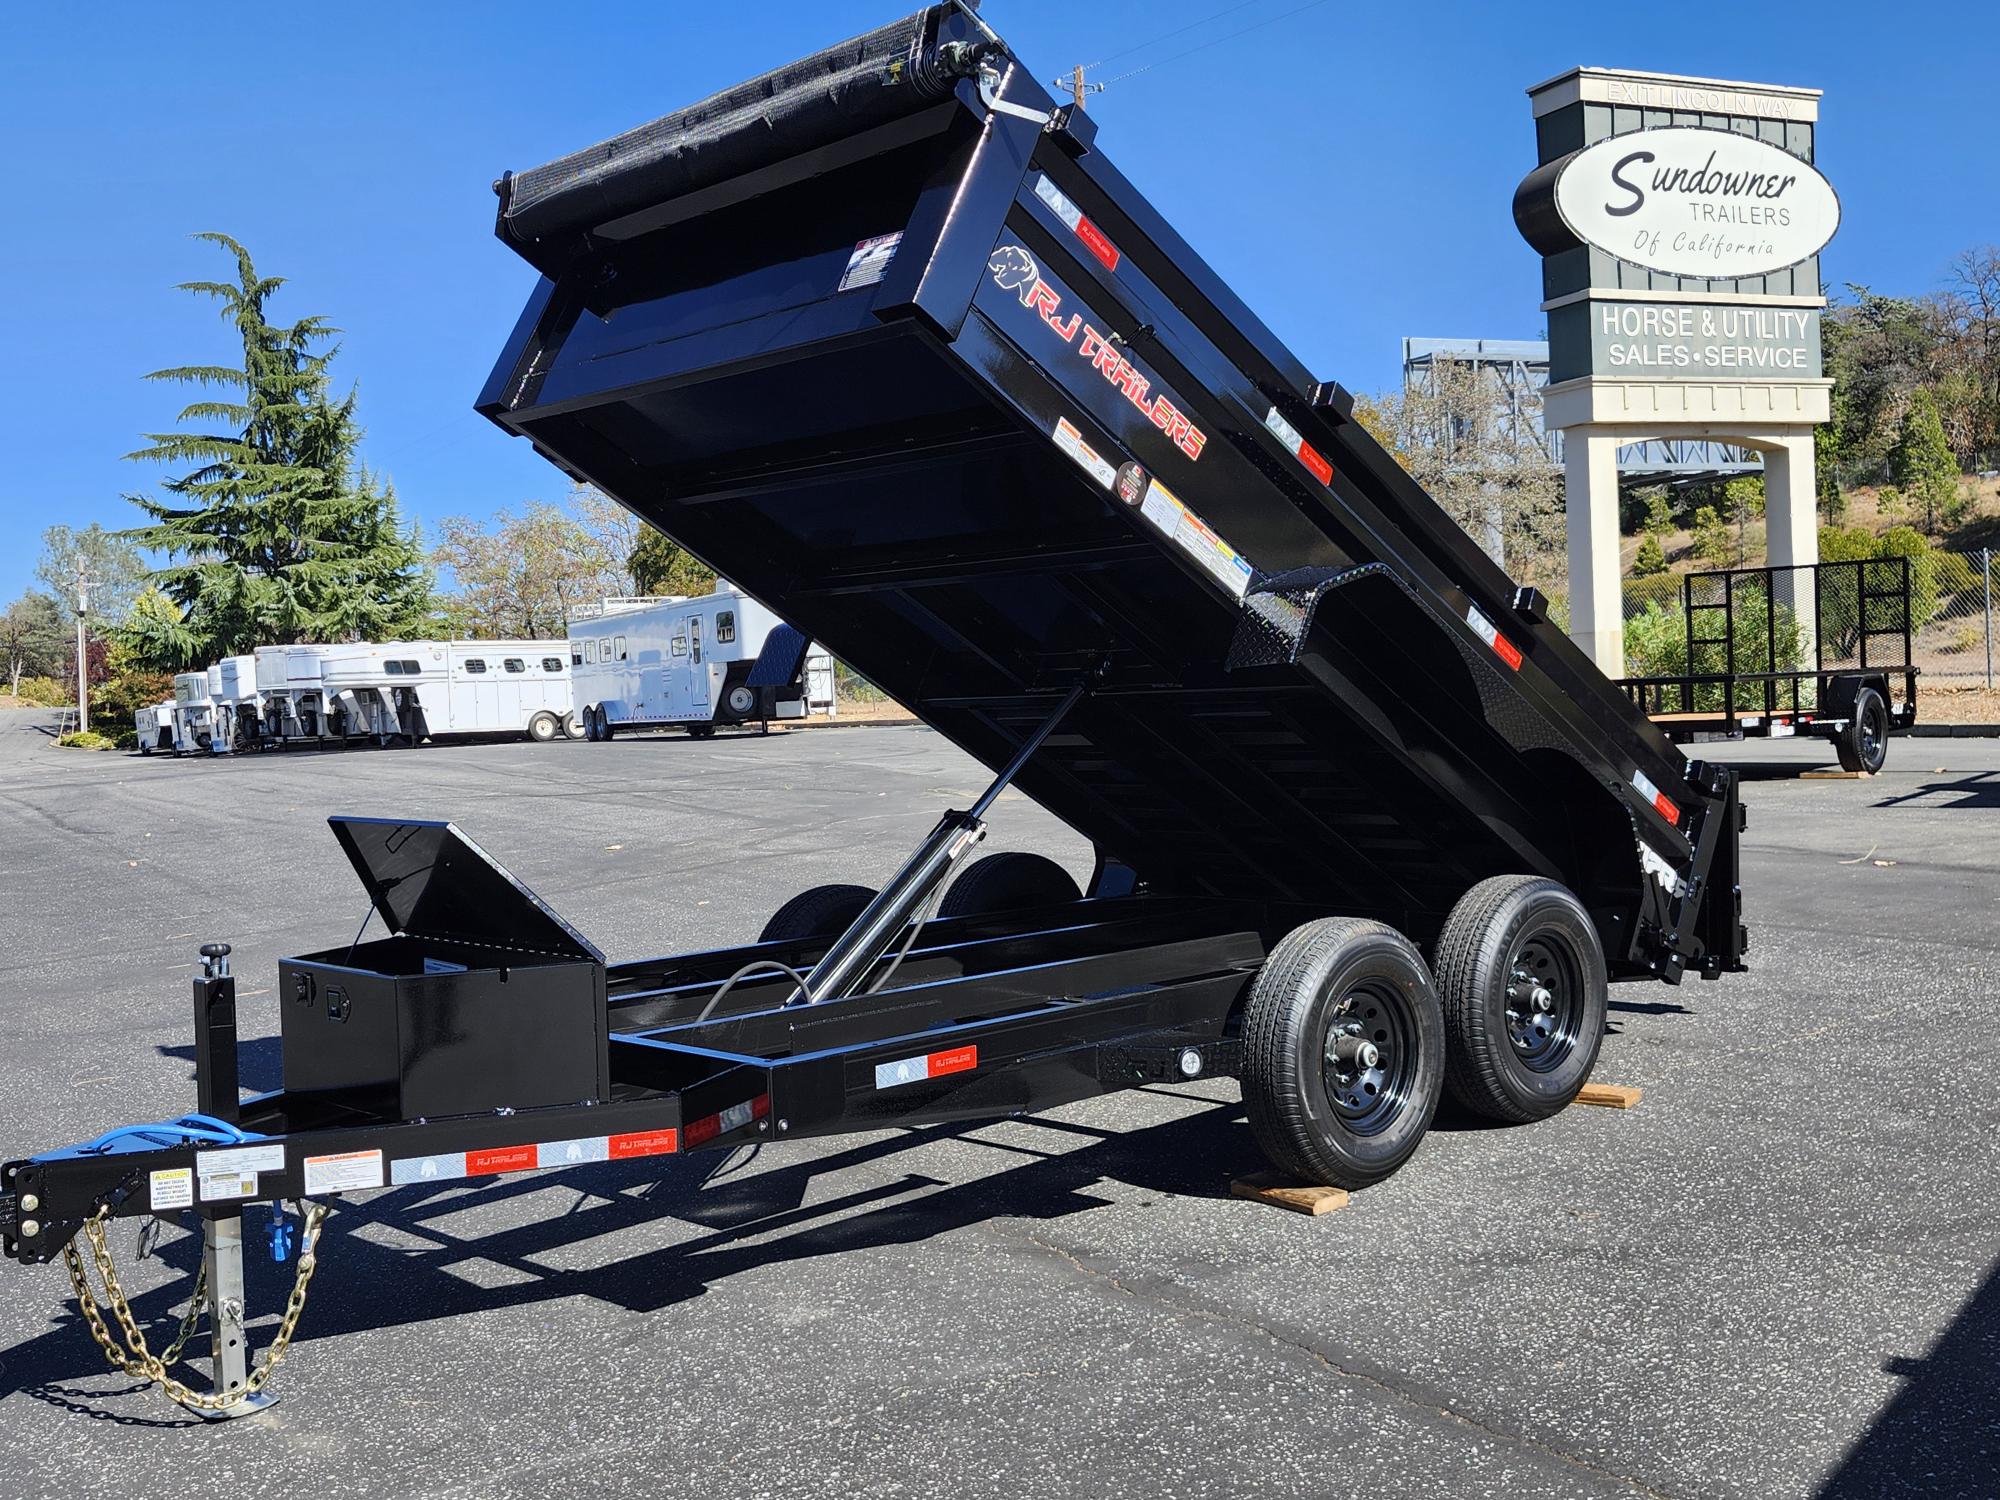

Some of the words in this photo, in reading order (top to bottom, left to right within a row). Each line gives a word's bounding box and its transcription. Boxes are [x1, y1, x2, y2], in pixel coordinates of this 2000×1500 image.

[1607, 82, 1654, 104] EXIT
[1660, 87, 1748, 113] LINCOLN
[1754, 96, 1793, 119] WAY
[1604, 150, 1796, 217] Sundowner
[1689, 202, 1791, 226] TRAILERS
[1634, 230, 1660, 256] Of
[1672, 231, 1774, 259] California
[1602, 306, 1694, 338] HORSE
[1701, 309, 1717, 337] &
[1722, 310, 1810, 340] UTILITY
[1025, 278, 1083, 344] RJ
[1078, 322, 1208, 462] TRAILERS
[1609, 343, 1691, 367] SALES
[1704, 345, 1808, 369] SERVICE
